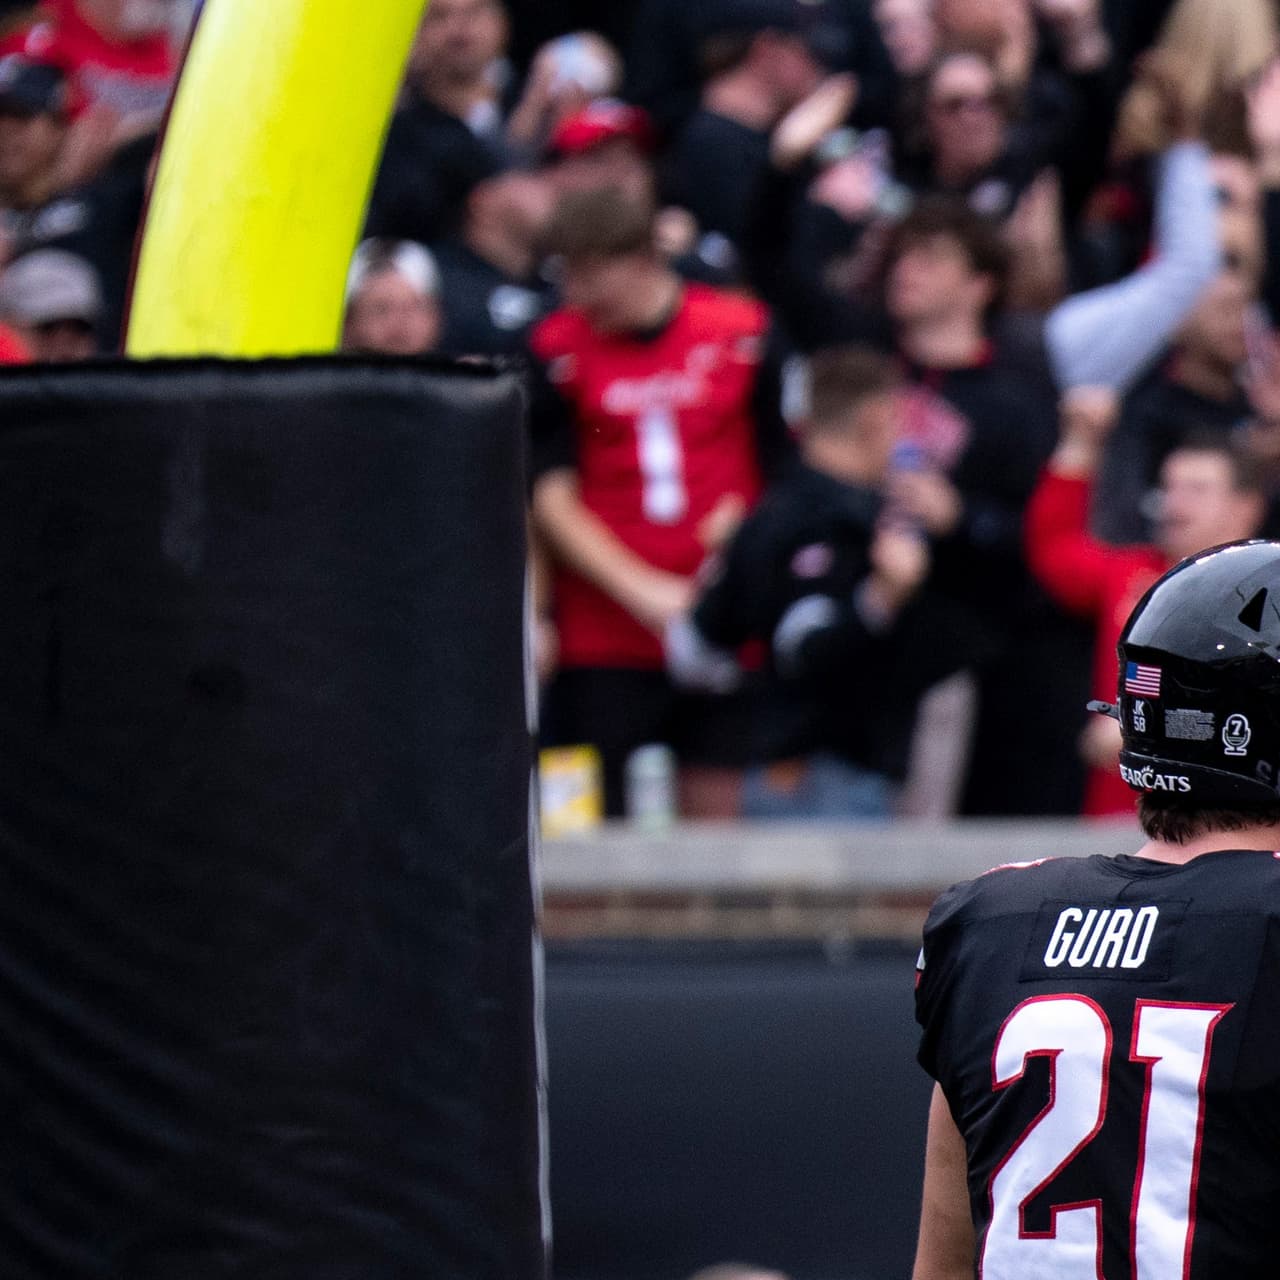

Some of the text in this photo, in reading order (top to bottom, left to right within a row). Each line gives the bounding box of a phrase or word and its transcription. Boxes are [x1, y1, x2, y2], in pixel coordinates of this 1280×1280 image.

[1231, 720, 1242, 736] 7
[1119, 763, 1192, 793] EARCATS
[1043, 906, 1160, 969] GURD
